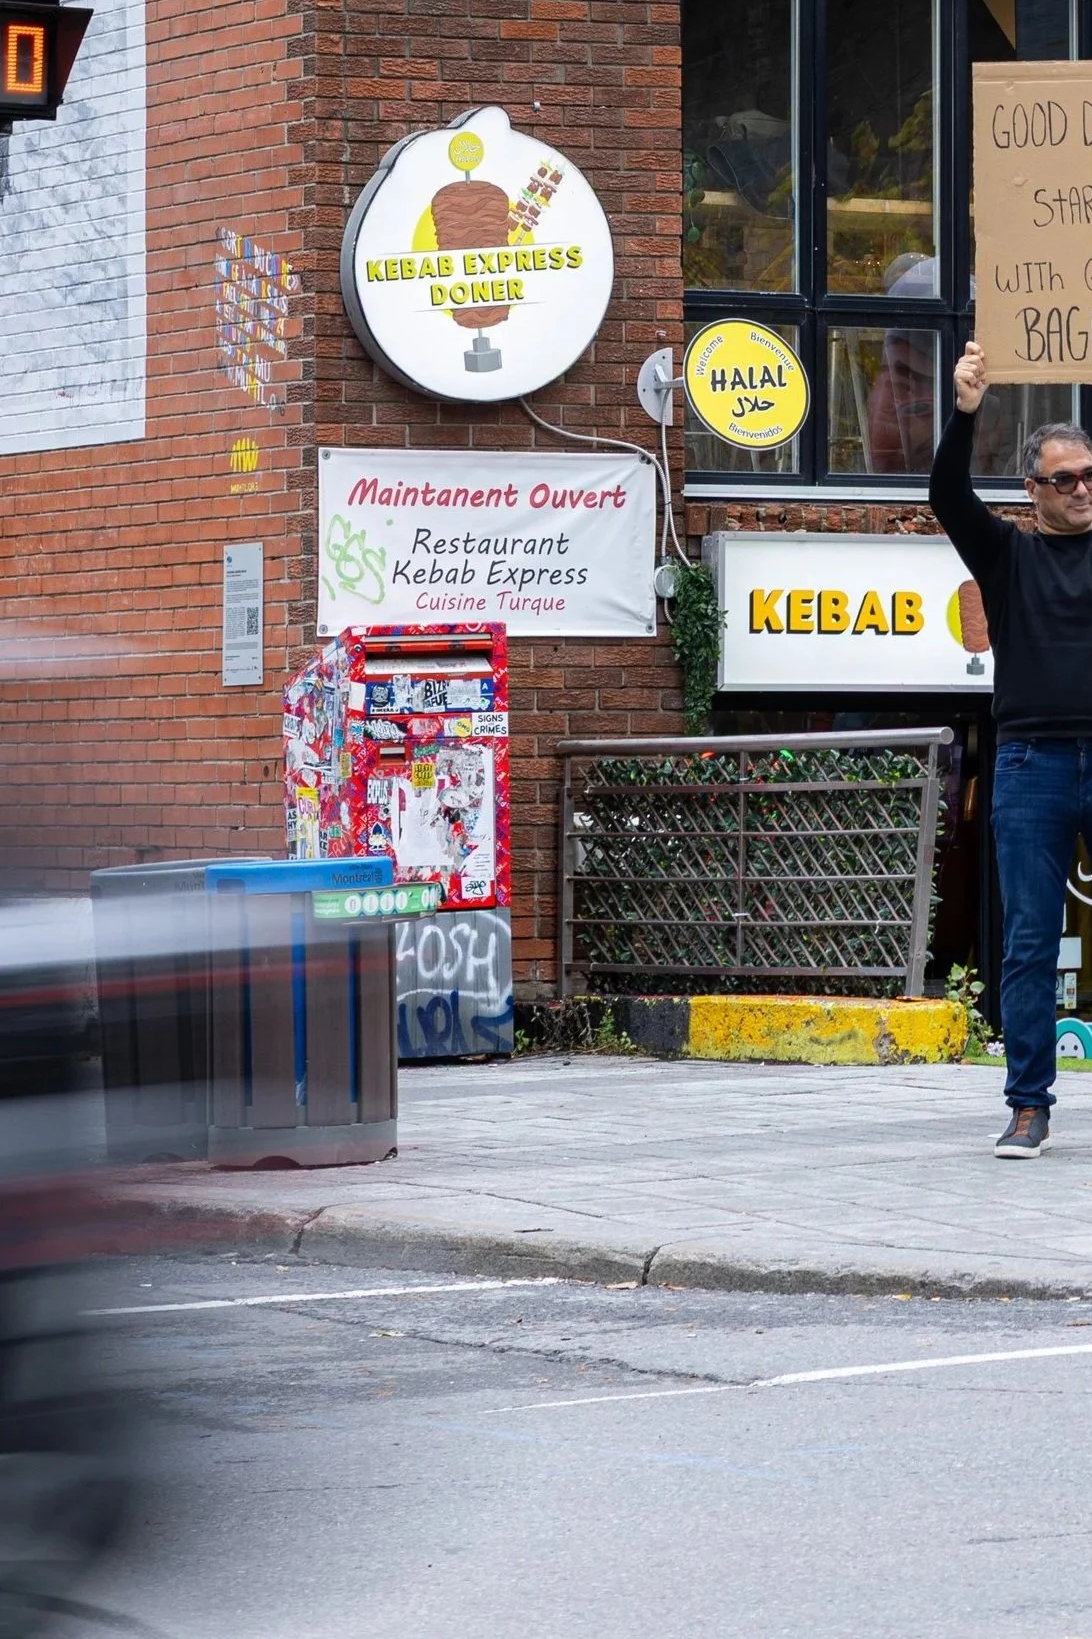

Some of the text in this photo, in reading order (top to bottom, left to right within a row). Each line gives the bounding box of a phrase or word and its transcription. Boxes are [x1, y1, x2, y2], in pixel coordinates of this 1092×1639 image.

[991, 100, 1068, 149] GOOD
[366, 245, 584, 283] KEBAB EXPRESS
[429, 278, 525, 307] DONER
[696, 331, 795, 376] Welcome Bienvenue
[710, 364, 787, 393] HALAL
[731, 395, 775, 418] حلال
[728, 422, 783, 439] Bienvenidos
[348, 477, 627, 509] Maintanent Ouvert
[411, 527, 570, 556] Restaurant
[391, 560, 588, 592] Kebab Express
[415, 590, 566, 616] Cuisine Turque
[749, 588, 925, 635] KEBAB
[473, 724, 507, 736] CRIMES
[477, 714, 504, 723] SIGNS
